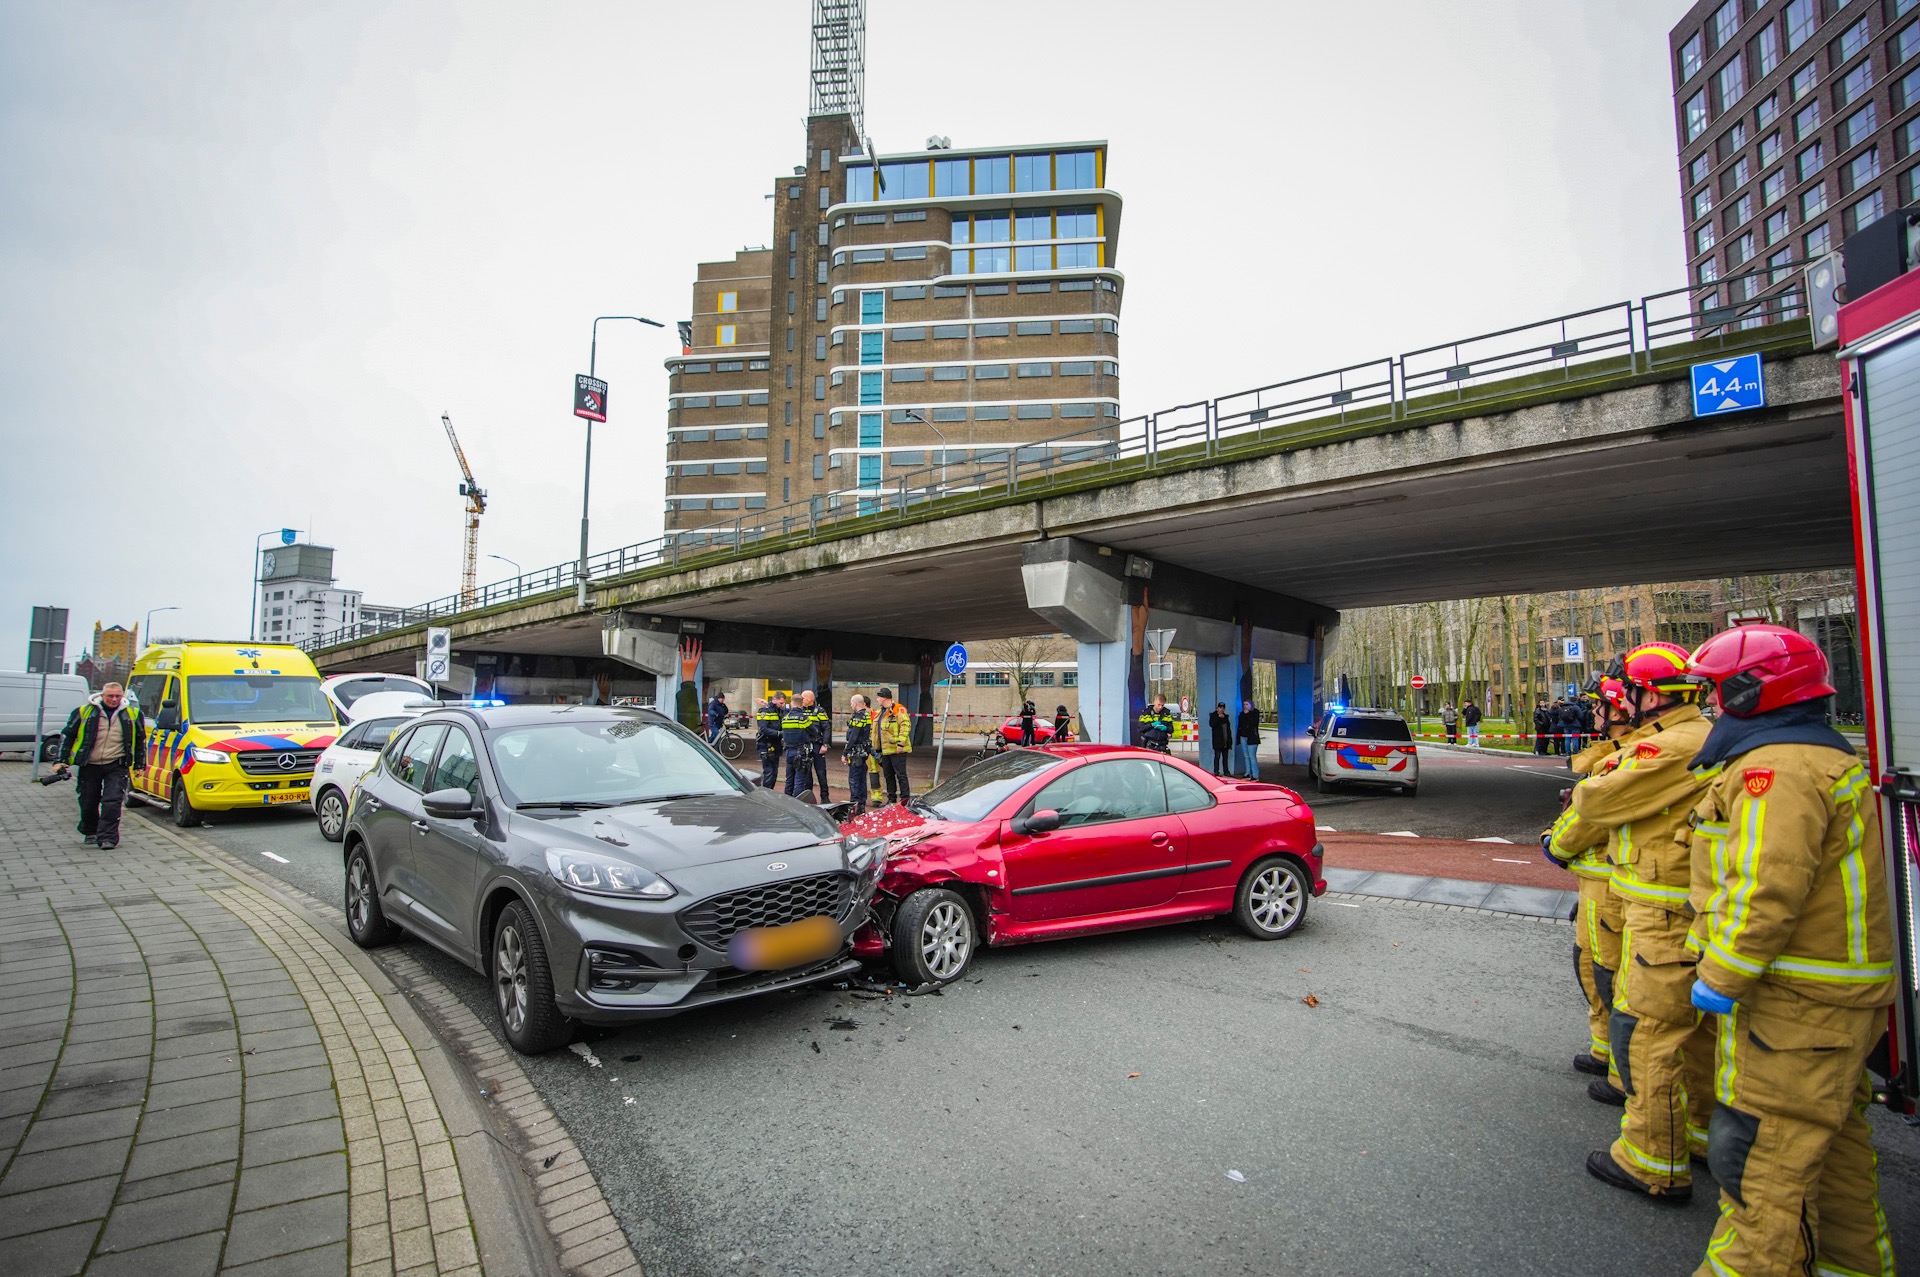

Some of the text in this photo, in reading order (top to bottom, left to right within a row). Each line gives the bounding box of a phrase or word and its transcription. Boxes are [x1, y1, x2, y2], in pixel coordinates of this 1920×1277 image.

[578, 376, 607, 391] CROSSFIT
[1699, 377, 1757, 396] 4,4 m
[270, 793, 307, 801] N-430-RV
